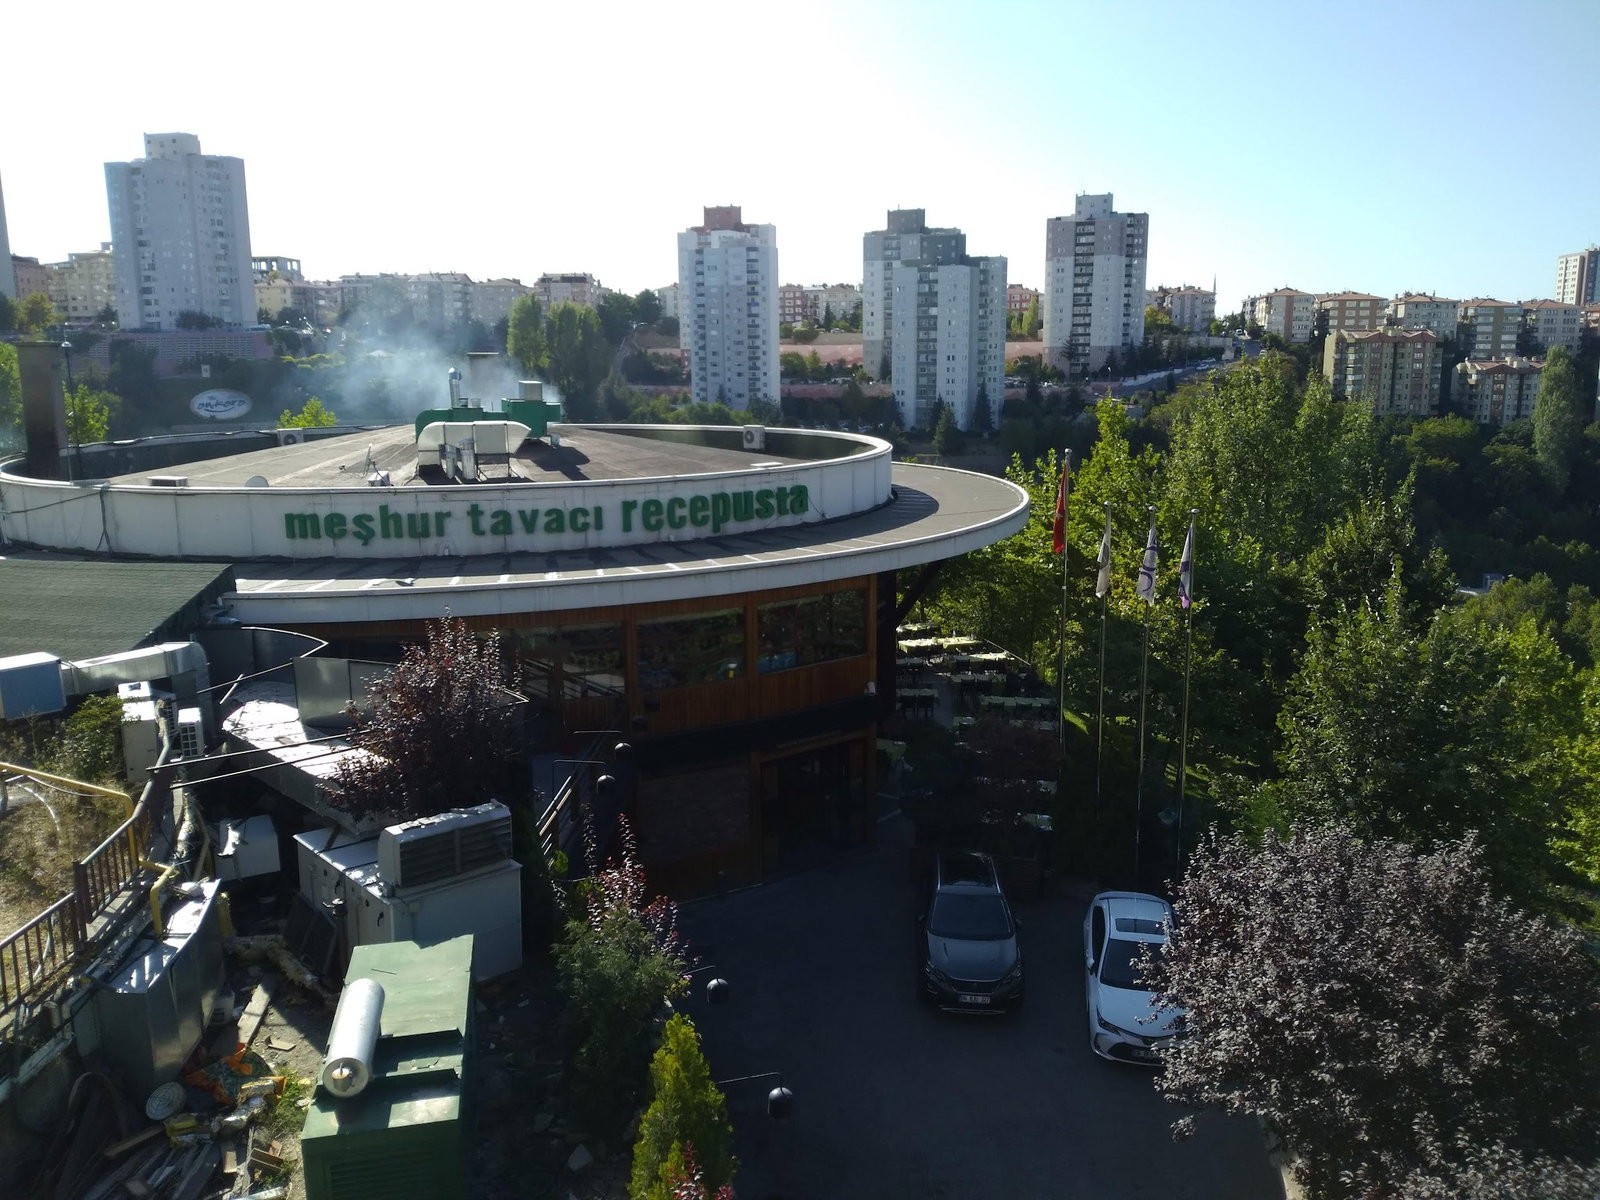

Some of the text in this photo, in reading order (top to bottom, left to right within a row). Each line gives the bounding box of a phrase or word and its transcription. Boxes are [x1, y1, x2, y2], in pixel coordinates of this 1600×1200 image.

[284, 484, 809, 546] meşhur tavacı recepusta
